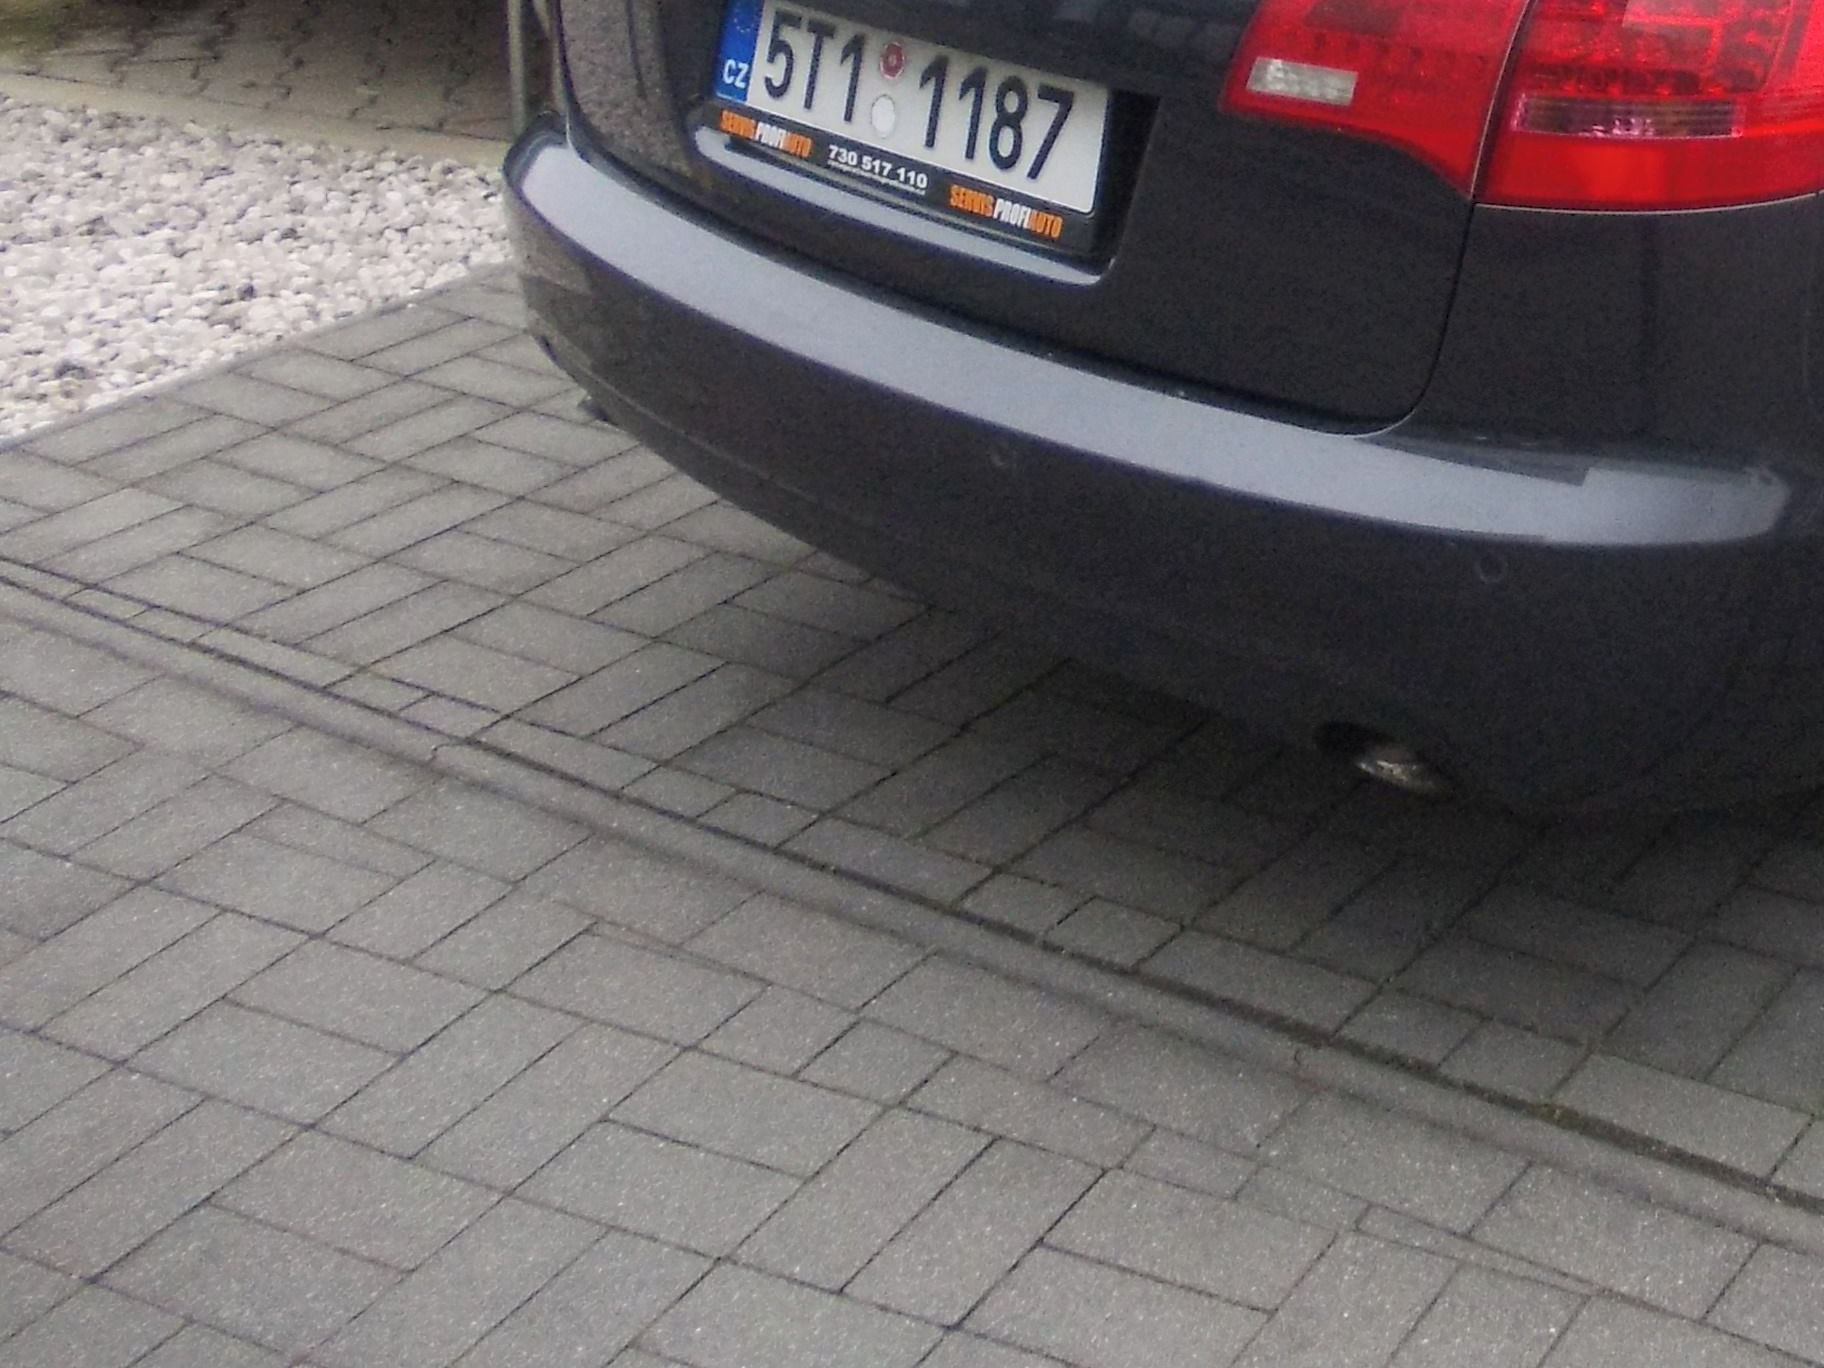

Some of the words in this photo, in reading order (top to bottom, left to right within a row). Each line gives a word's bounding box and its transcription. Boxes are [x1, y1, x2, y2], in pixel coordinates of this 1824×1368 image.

[723, 59, 749, 89] CZ
[764, 10, 866, 124] 5T1
[919, 54, 1076, 180] 1187
[829, 145, 858, 167] 730
[861, 155, 893, 178] 517
[896, 167, 928, 189] 110
